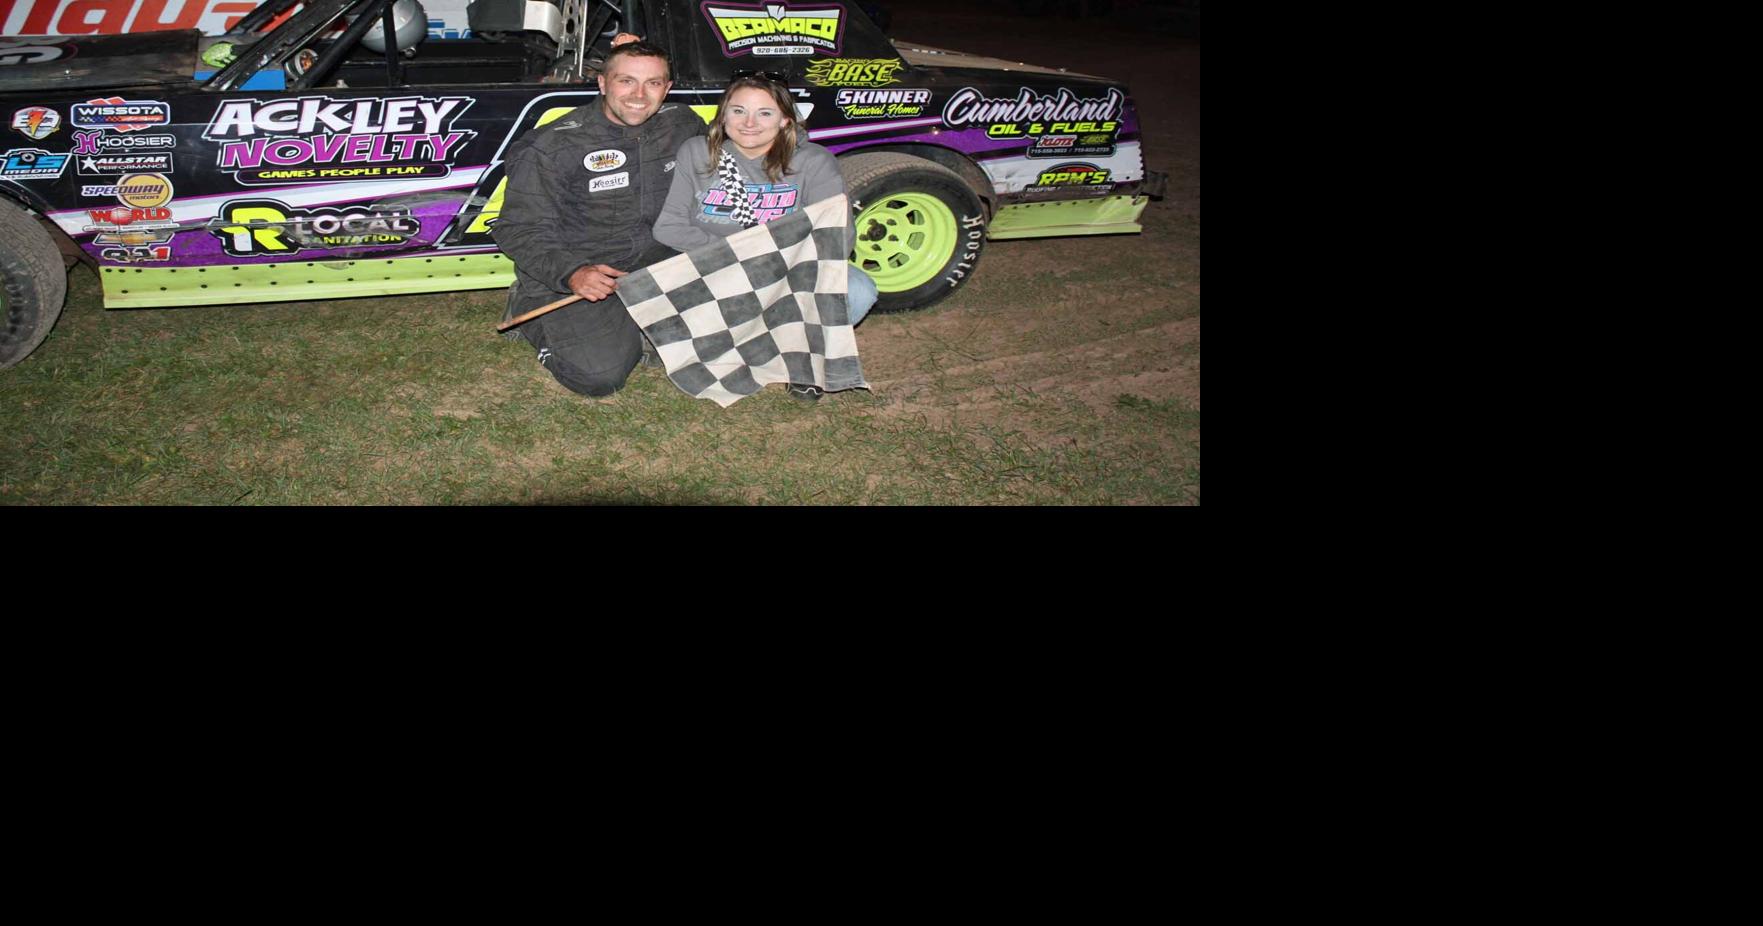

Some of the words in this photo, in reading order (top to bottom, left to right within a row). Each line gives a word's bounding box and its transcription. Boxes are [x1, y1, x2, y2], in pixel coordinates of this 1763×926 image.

[828, 63, 895, 81] BASE
[838, 90, 929, 105] SKINNER
[78, 106, 164, 115] WISSOTA
[844, 104, 886, 116] Funeral
[887, 103, 921, 115] Homes
[946, 90, 1118, 125] Cumberland
[209, 98, 461, 137] ACKLEY
[989, 123, 1022, 135] OIL
[1028, 123, 1044, 134] &
[1050, 122, 1117, 133] FUELS
[97, 136, 173, 147] HOOSIER
[221, 133, 461, 167] NOVELTY
[97, 156, 168, 164] ALLSTAR
[258, 169, 316, 179] GAMES
[319, 167, 381, 178] PEOPLE
[386, 166, 425, 175] PLAY
[1038, 171, 1107, 187] RPM'S
[82, 184, 164, 196] SPEEDWAY
[592, 176, 626, 189] Hoosier
[90, 207, 172, 225] WORLD
[294, 212, 409, 235] LOCAL
[945, 214, 984, 287] Hoosier
